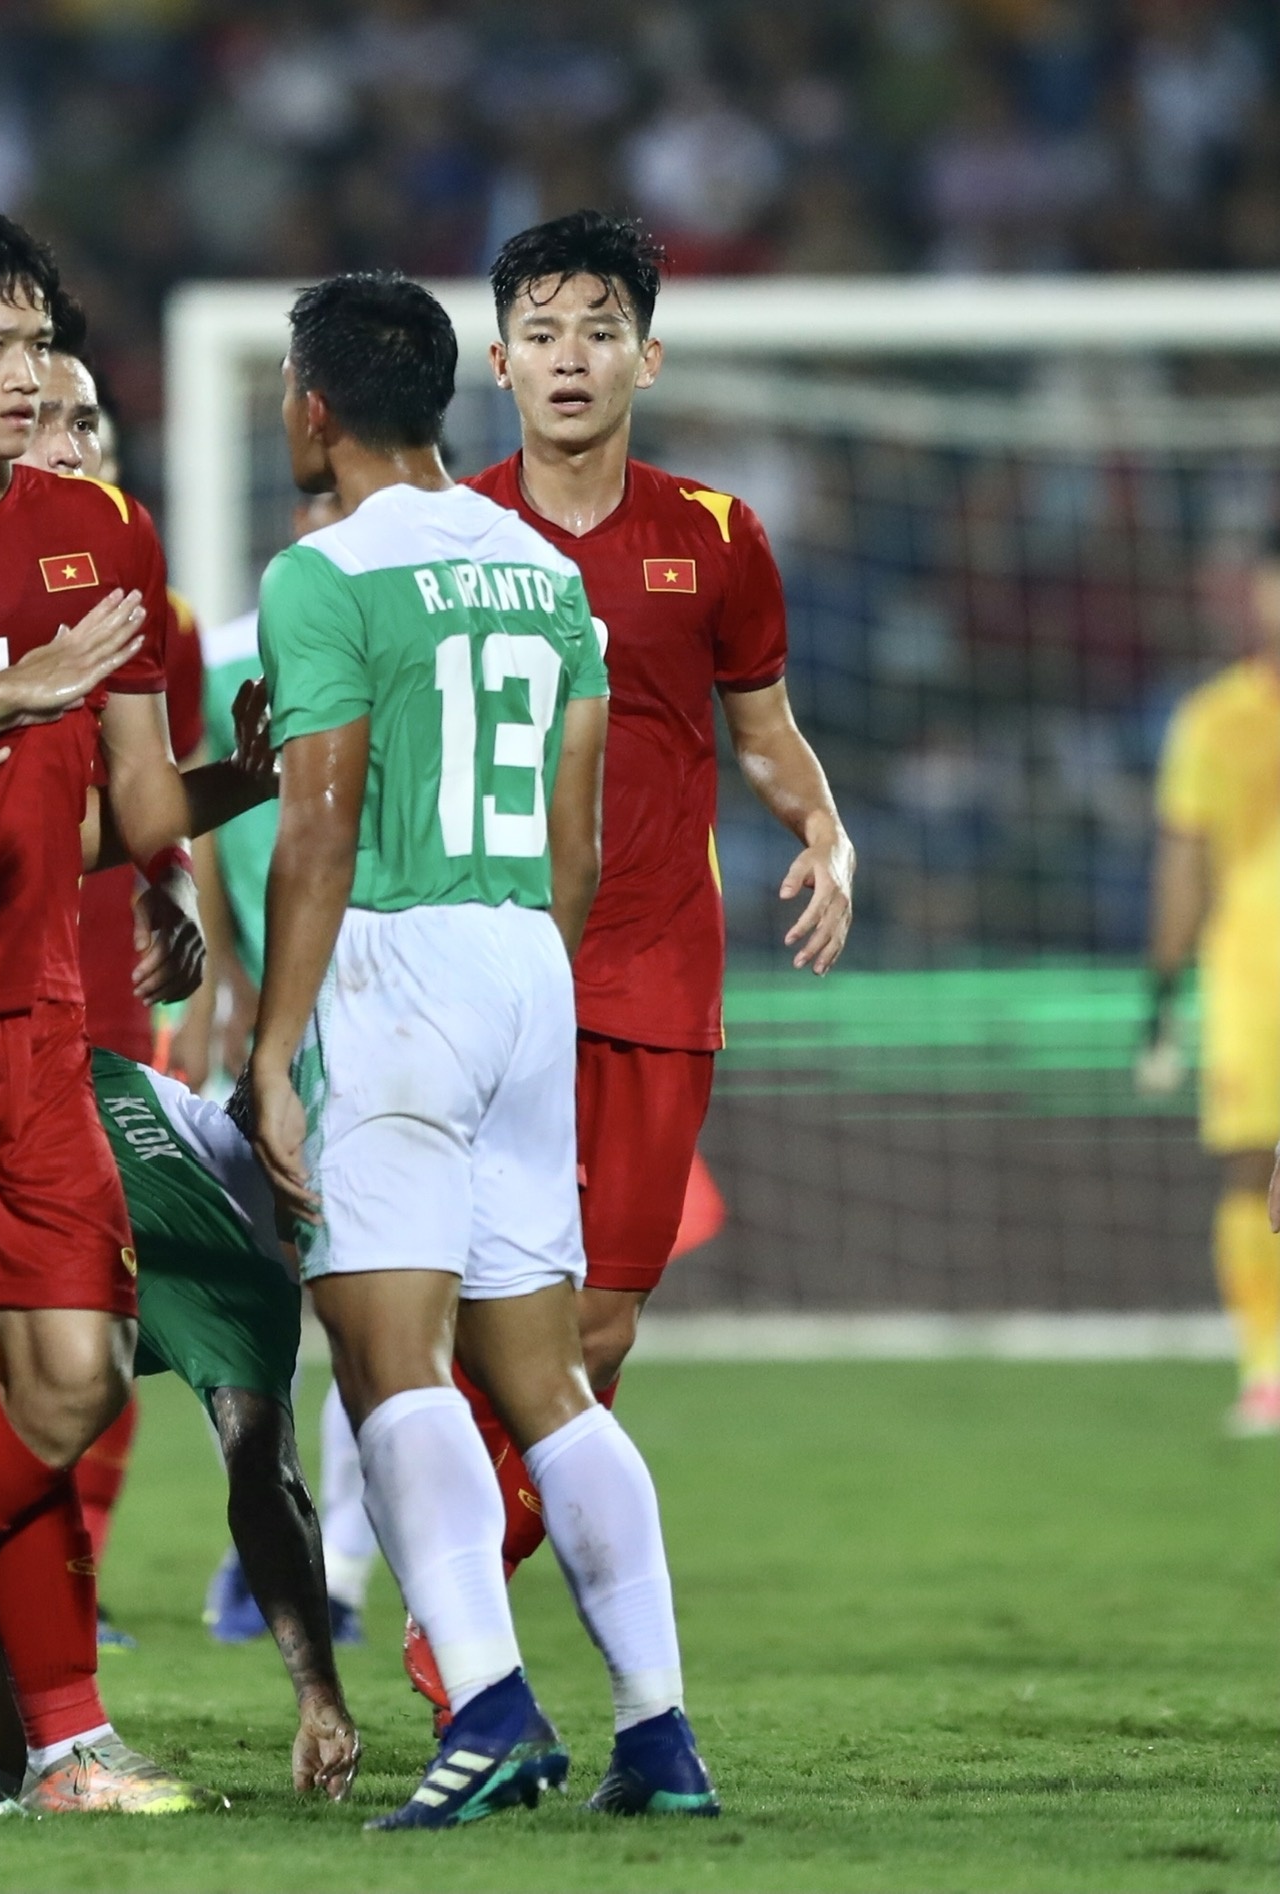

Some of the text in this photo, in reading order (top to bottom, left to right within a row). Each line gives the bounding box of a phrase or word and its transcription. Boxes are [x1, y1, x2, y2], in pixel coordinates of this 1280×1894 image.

[414, 568, 454, 614] R.
[435, 633, 562, 858] 13
[104, 1096, 183, 1161] KLOK
